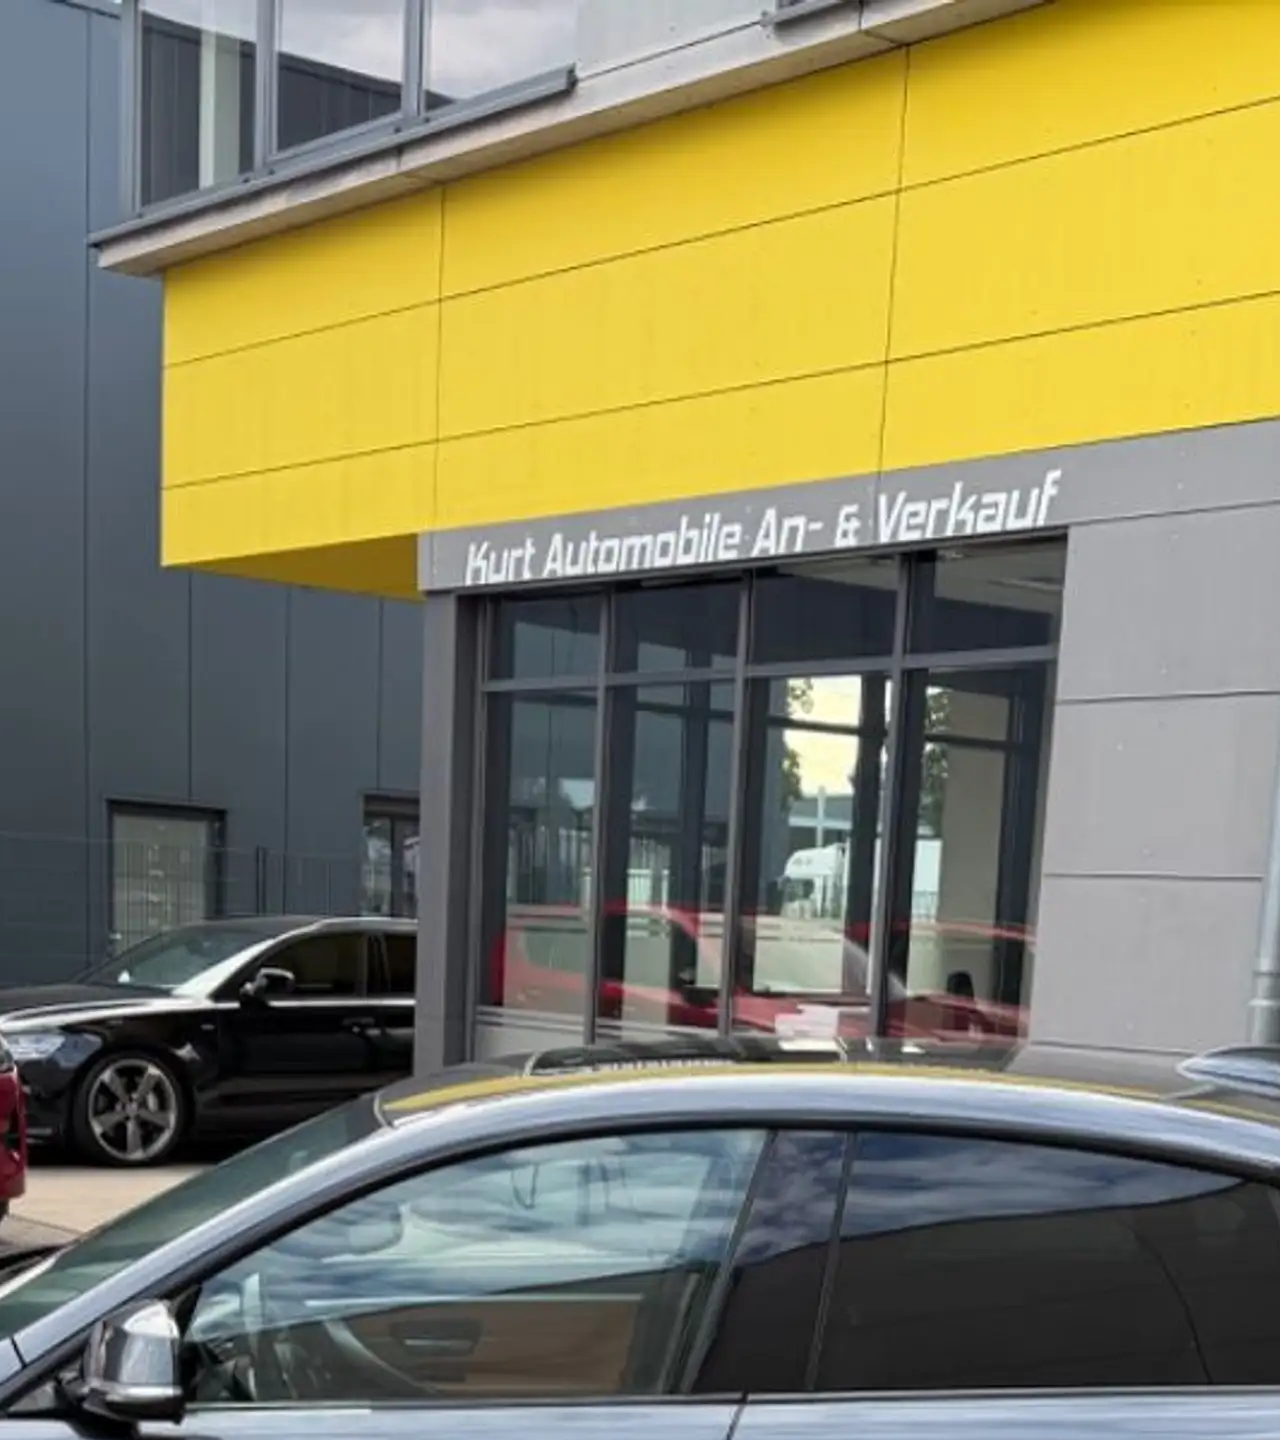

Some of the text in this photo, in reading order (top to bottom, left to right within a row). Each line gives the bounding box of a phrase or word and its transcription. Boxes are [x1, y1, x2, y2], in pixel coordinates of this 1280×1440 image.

[464, 468, 1063, 587] Kurt Automobile An- & Verkauf
